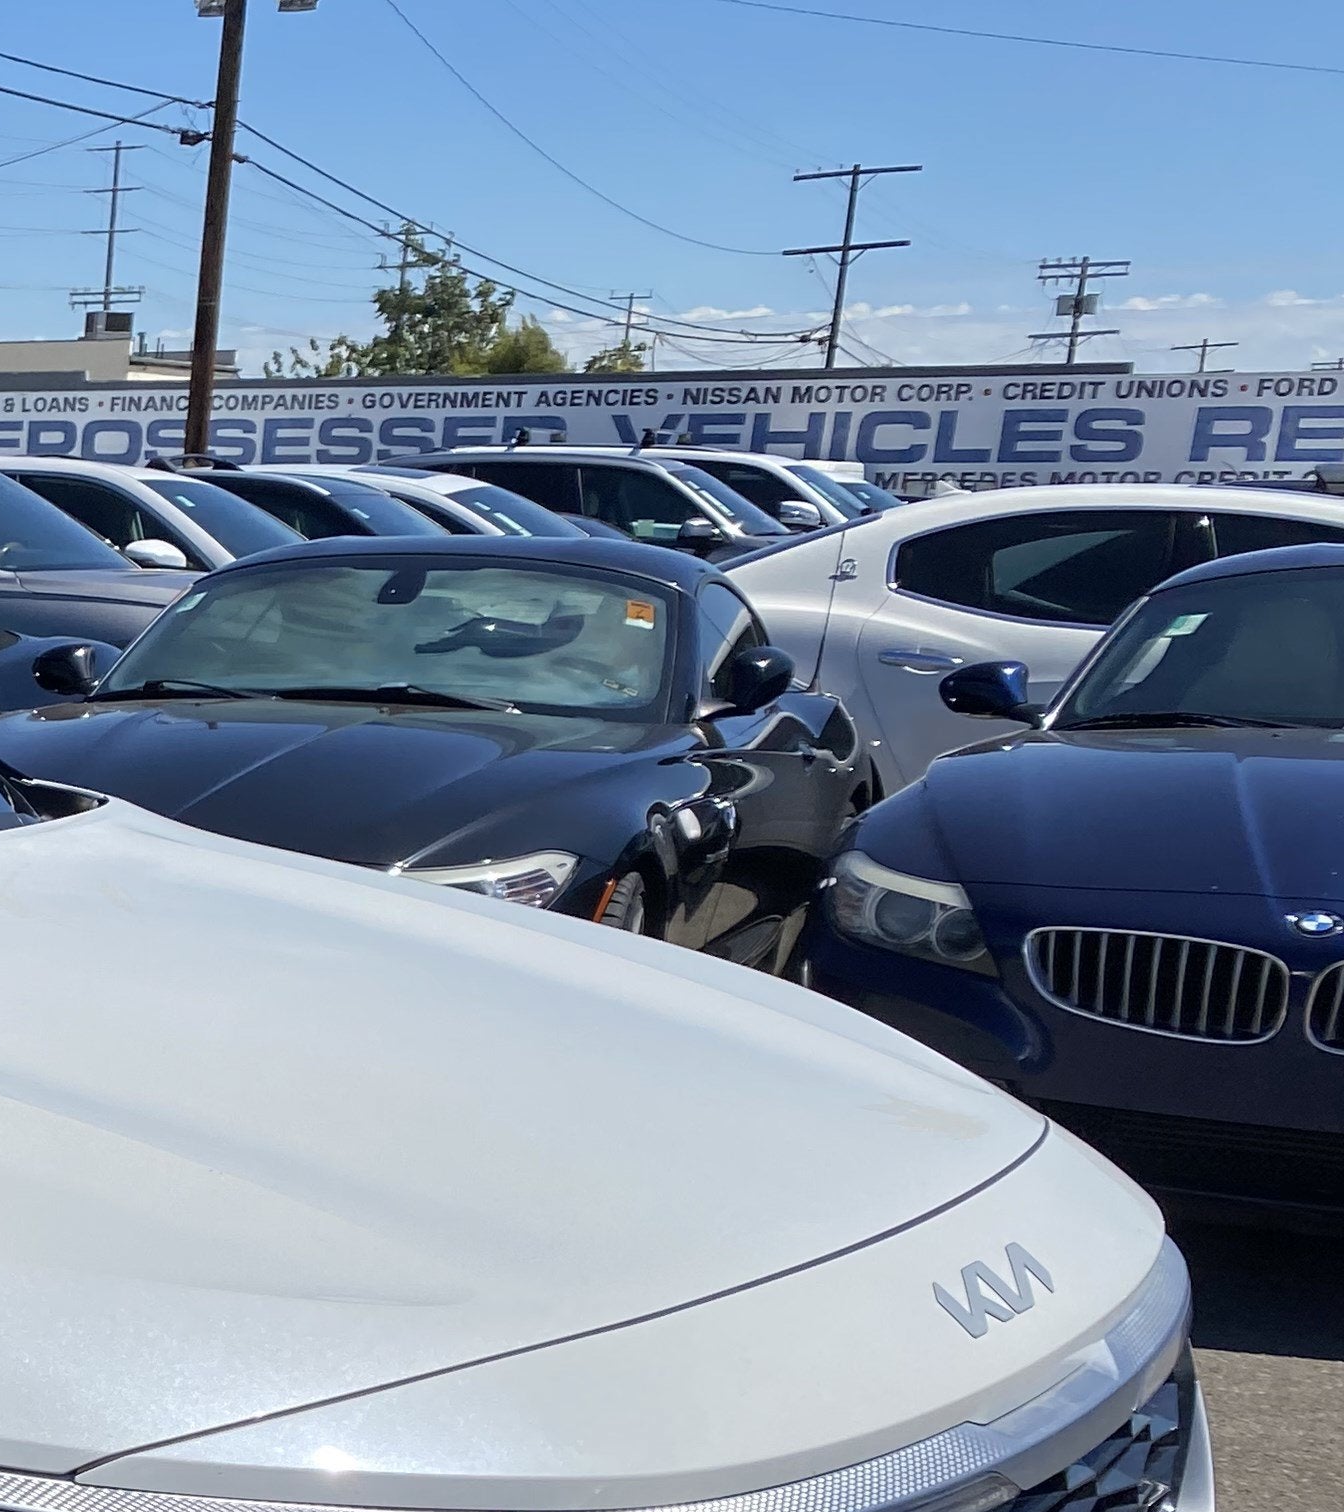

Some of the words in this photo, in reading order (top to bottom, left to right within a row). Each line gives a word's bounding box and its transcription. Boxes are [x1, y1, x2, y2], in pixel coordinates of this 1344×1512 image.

[3, 399, 17, 413] &
[21, 396, 90, 414] LOANS
[110, 395, 190, 413] FINANC
[211, 392, 340, 412] COMPANIES
[362, 390, 528, 410] GOVERNMENT
[534, 388, 660, 408] AGENCIES
[682, 386, 782, 406] NISSAN
[790, 383, 887, 405] MOTOR
[897, 382, 973, 402] CORP.
[1002, 380, 1106, 402] CREDIT
[1115, 379, 1230, 399] UNIONS
[1256, 377, 1339, 397] FORD
[611, 407, 1146, 464] VEHICLES
[932, 1241, 1055, 1340] KIA
